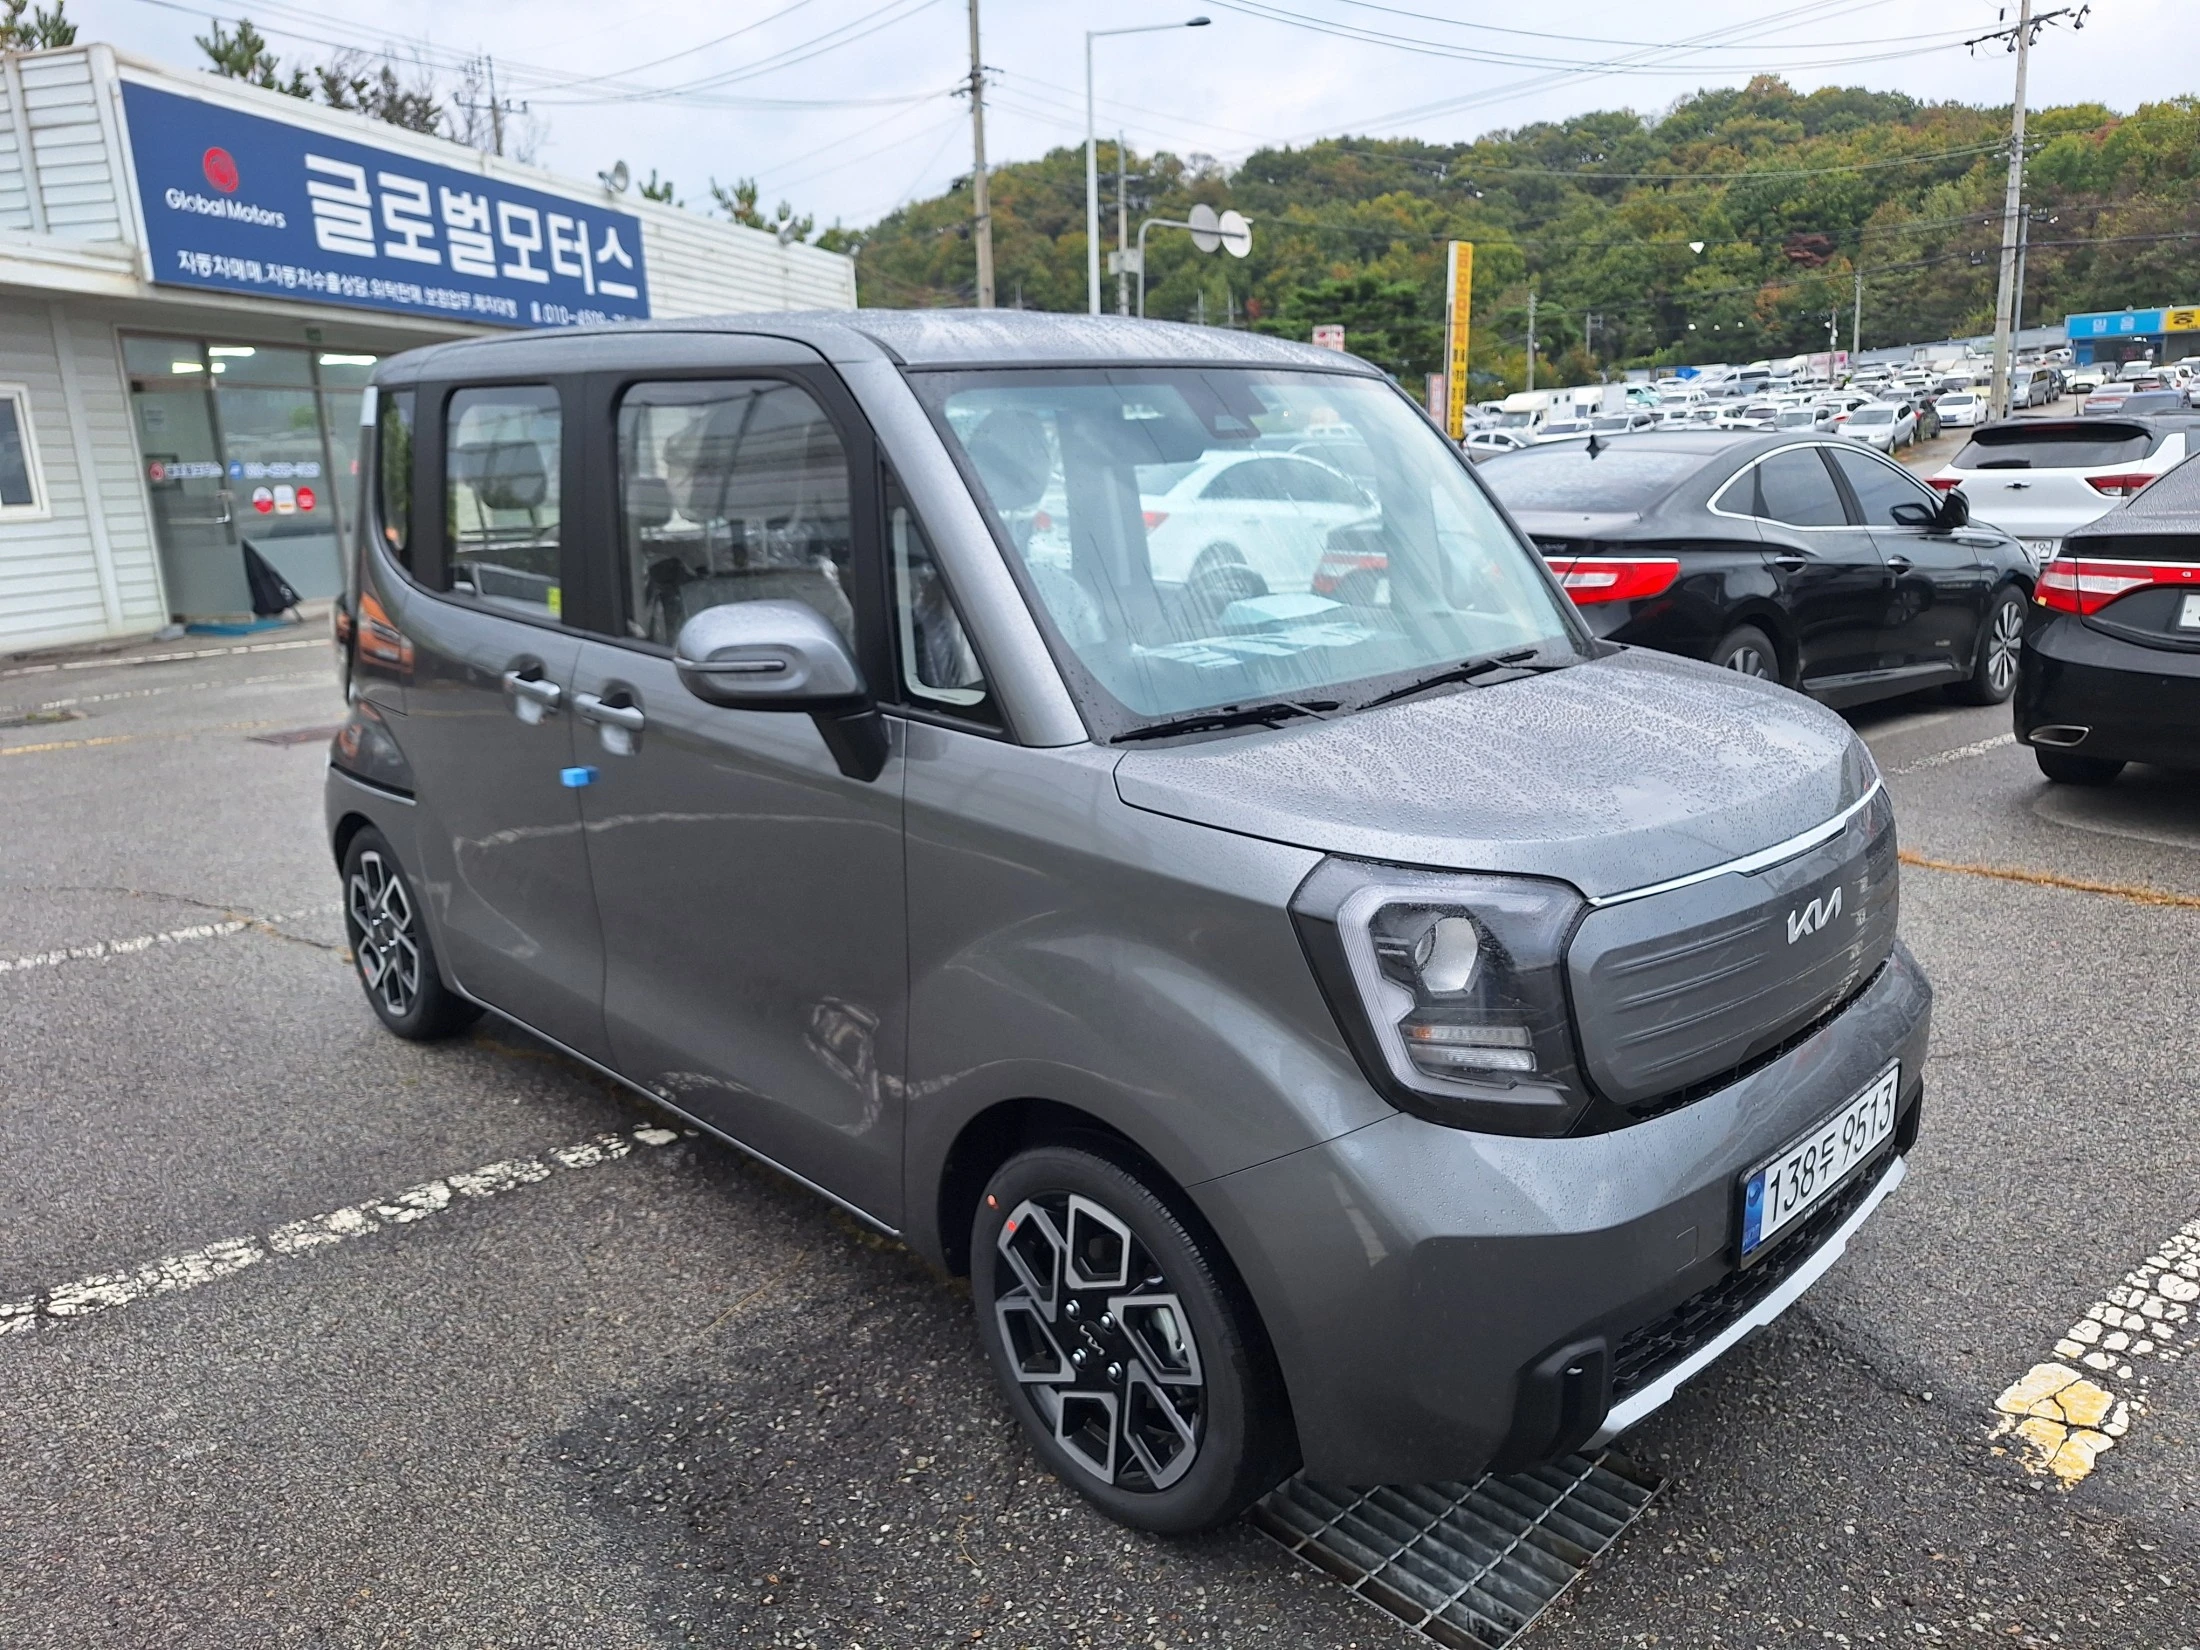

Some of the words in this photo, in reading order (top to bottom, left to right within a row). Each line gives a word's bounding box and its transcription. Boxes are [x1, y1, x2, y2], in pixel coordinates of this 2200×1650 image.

[165, 187, 226, 218] Global
[227, 200, 287, 229] Motors
[304, 153, 639, 299] 글로벌모터스
[1770, 1131, 1836, 1222] 138두
[1843, 1080, 1893, 1166] 9513
